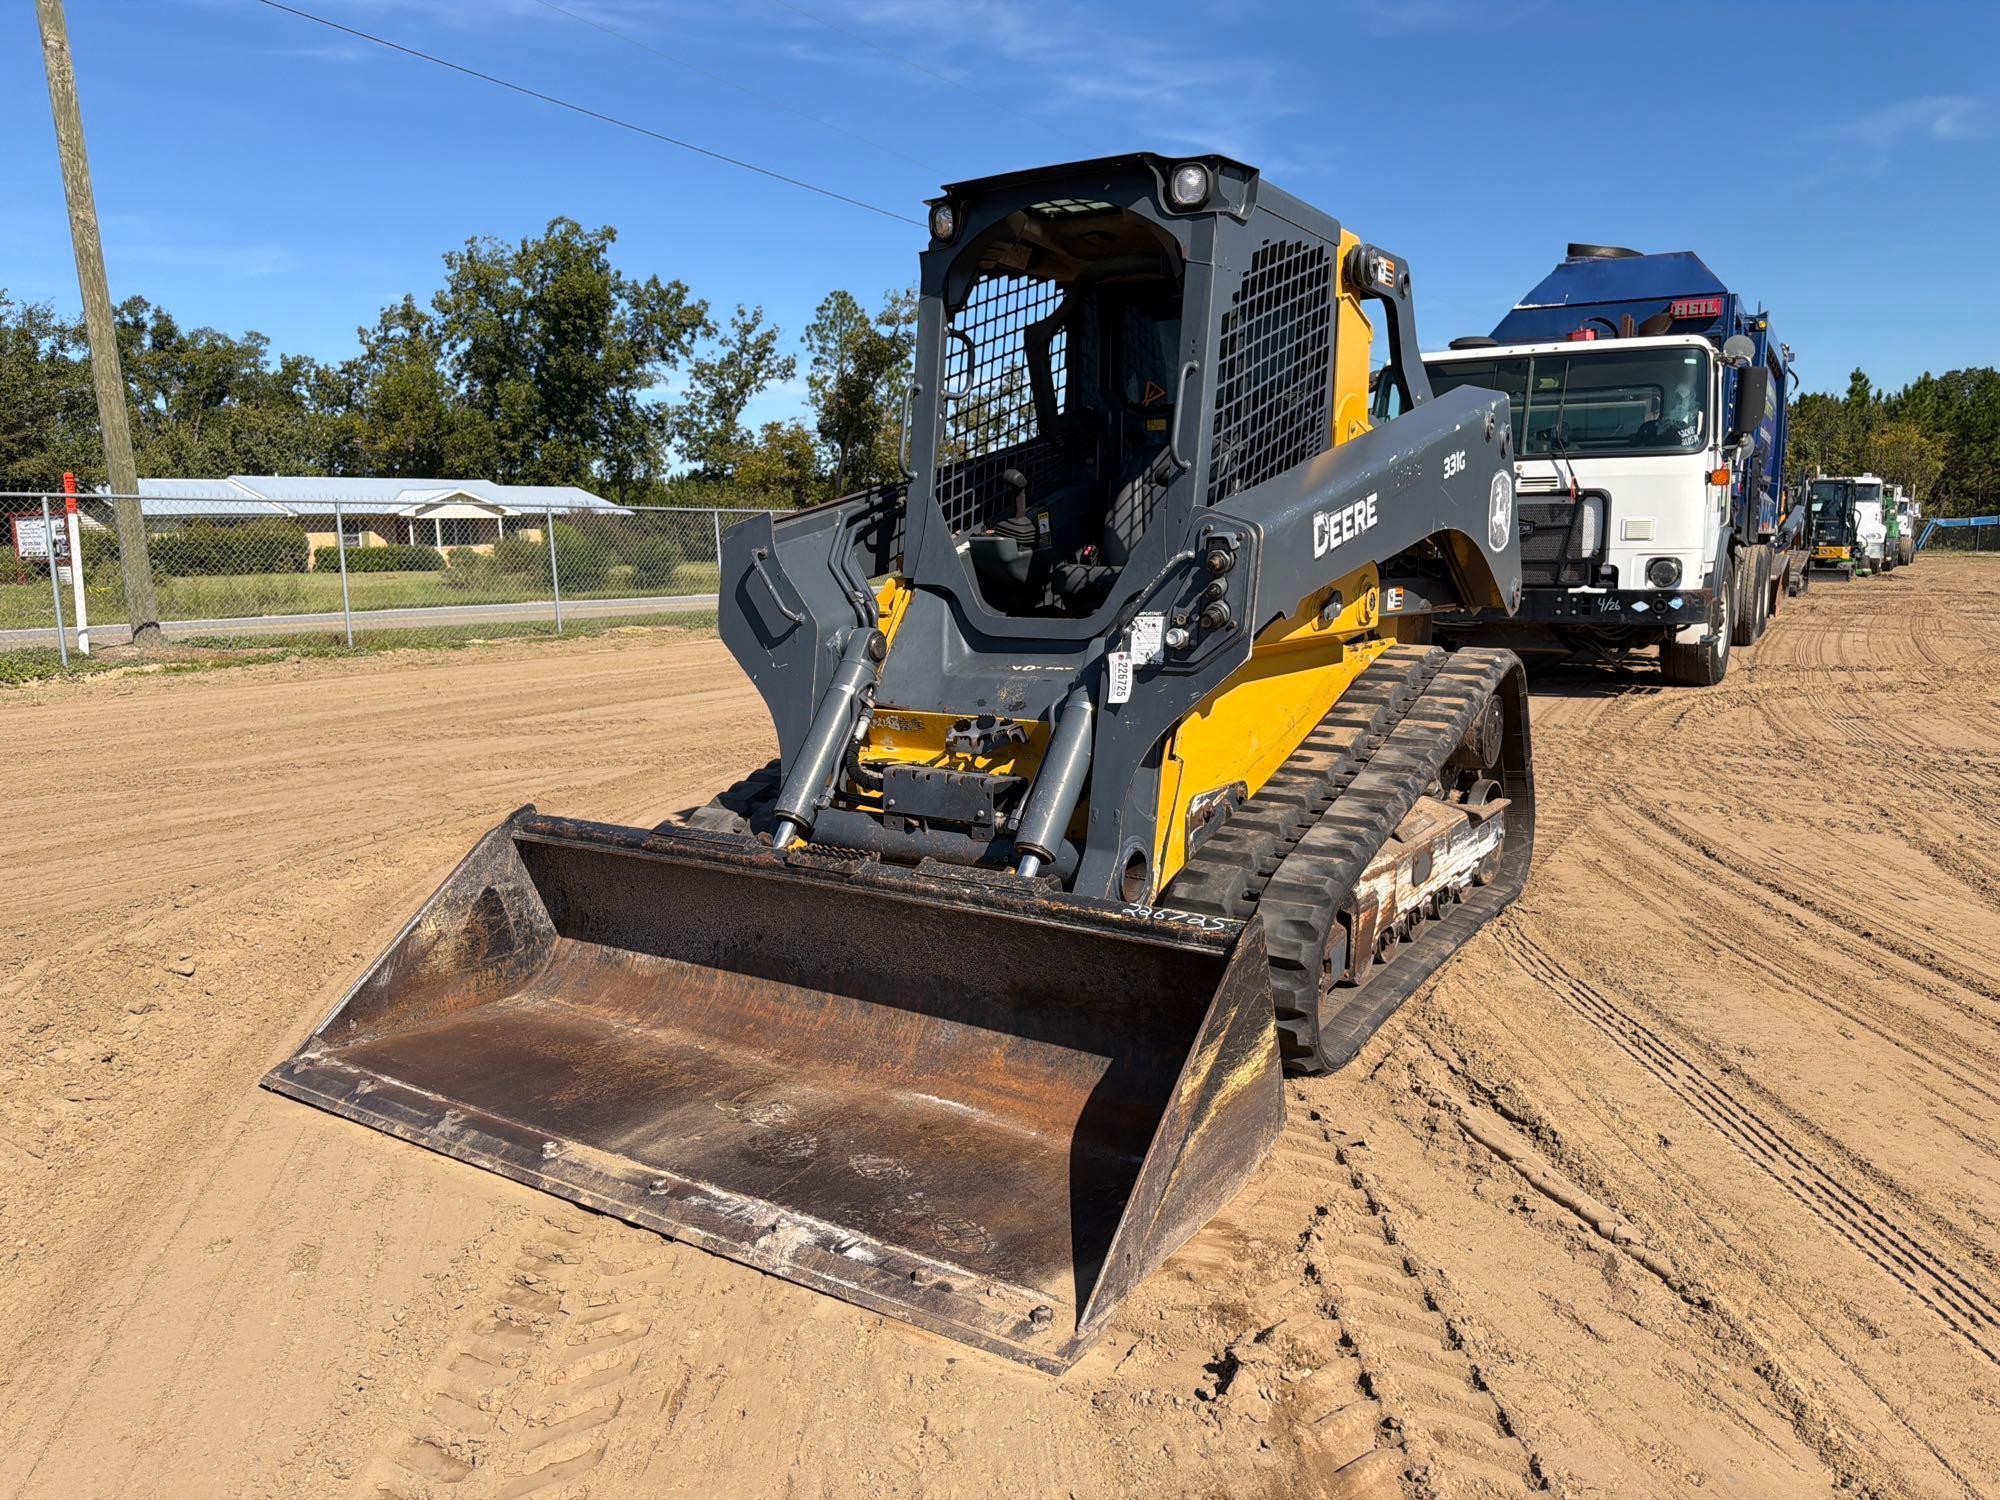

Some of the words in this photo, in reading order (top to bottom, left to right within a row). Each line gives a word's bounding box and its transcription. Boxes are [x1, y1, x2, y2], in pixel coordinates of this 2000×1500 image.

[1674, 301, 1717, 316] HEIL
[1443, 450, 1466, 479] 331G
[1313, 491, 1378, 559] DEERE
[1597, 597, 1621, 613] 4/26
[1115, 662, 1129, 697] 226725
[1121, 903, 1236, 931] 226725
